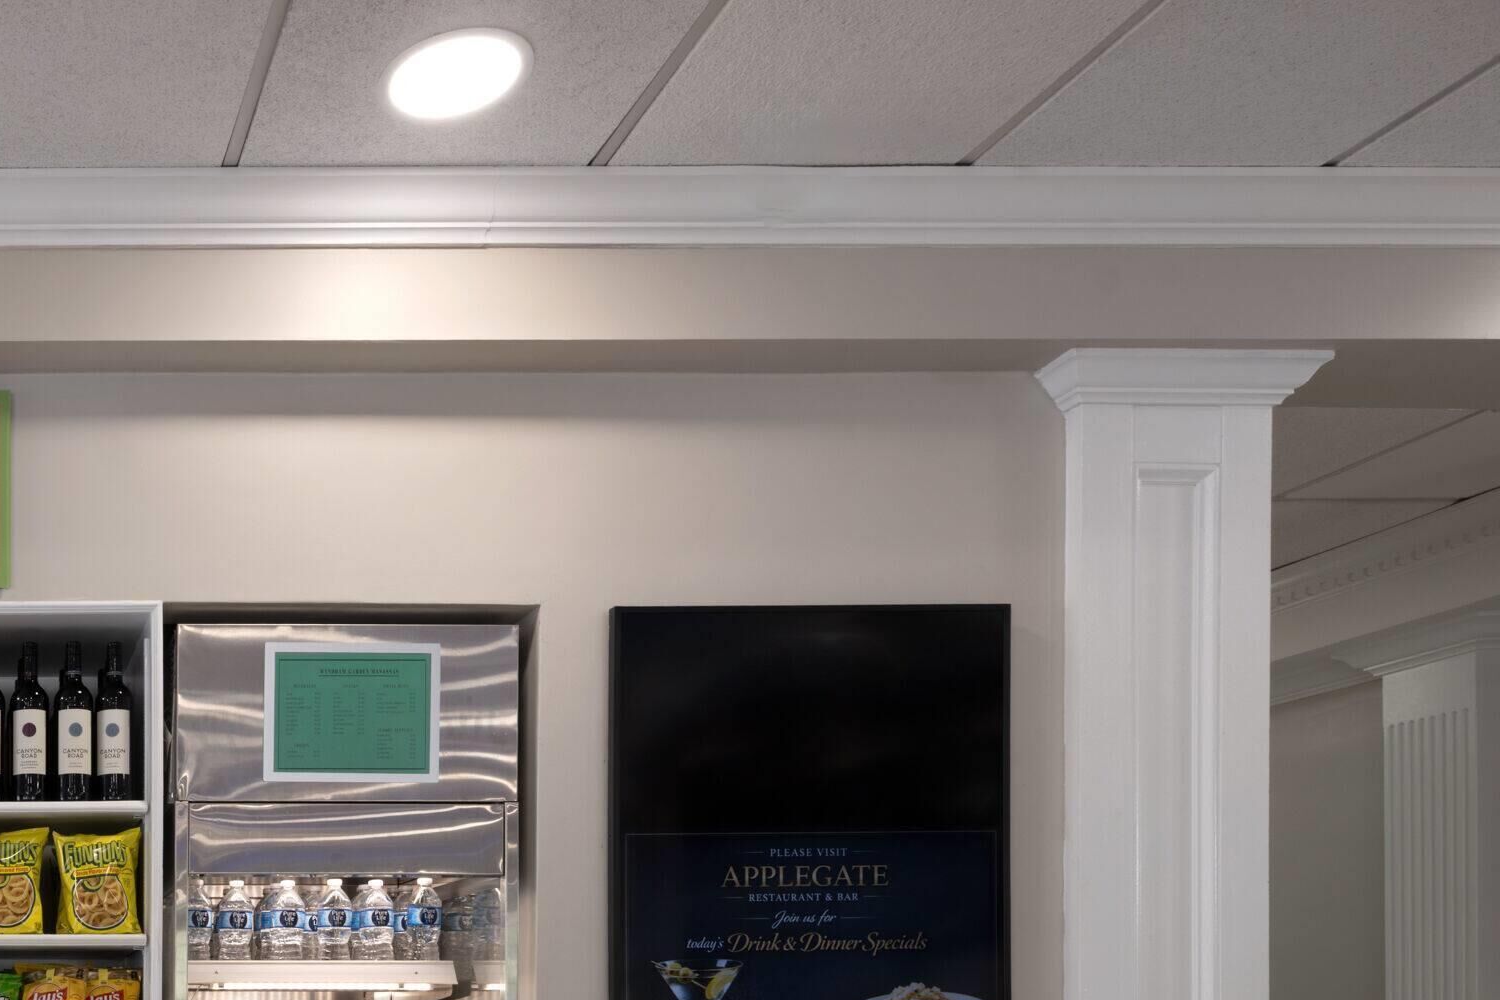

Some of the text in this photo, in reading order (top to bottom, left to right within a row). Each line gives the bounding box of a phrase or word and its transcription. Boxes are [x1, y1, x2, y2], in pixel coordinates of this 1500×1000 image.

[770, 848, 848, 857] PLEASE VISIT
[722, 864, 889, 888] APPLEGATE
[749, 893, 859, 903] RESTAURANT & BAR
[772, 910, 836, 929] Join us for
[687, 931, 928, 956] today's Drink & Dinner Specials
